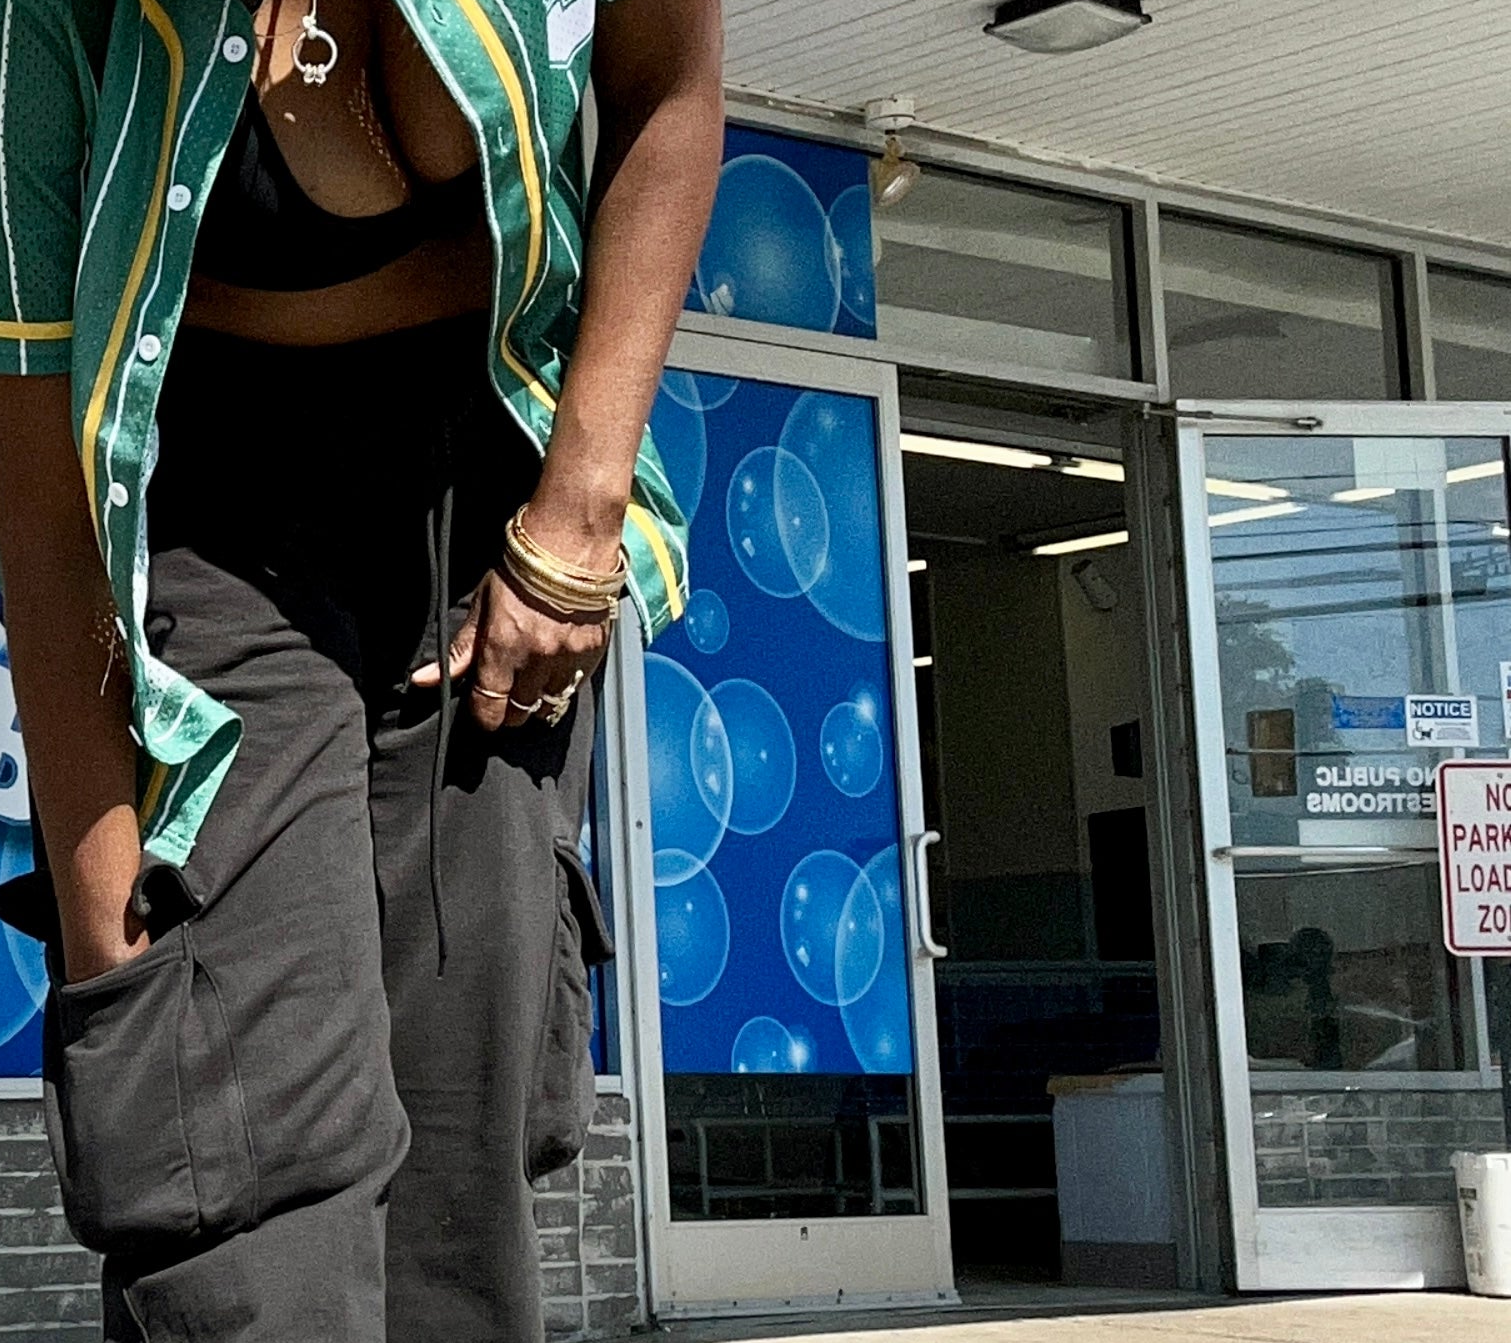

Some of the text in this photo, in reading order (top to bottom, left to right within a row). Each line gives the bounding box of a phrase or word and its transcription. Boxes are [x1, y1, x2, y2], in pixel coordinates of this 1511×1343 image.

[1410, 702, 1471, 717] NOTICE
[1452, 823, 1511, 852] PARK
[1456, 864, 1511, 892] LOAD
[1478, 904, 1511, 933] ZO
